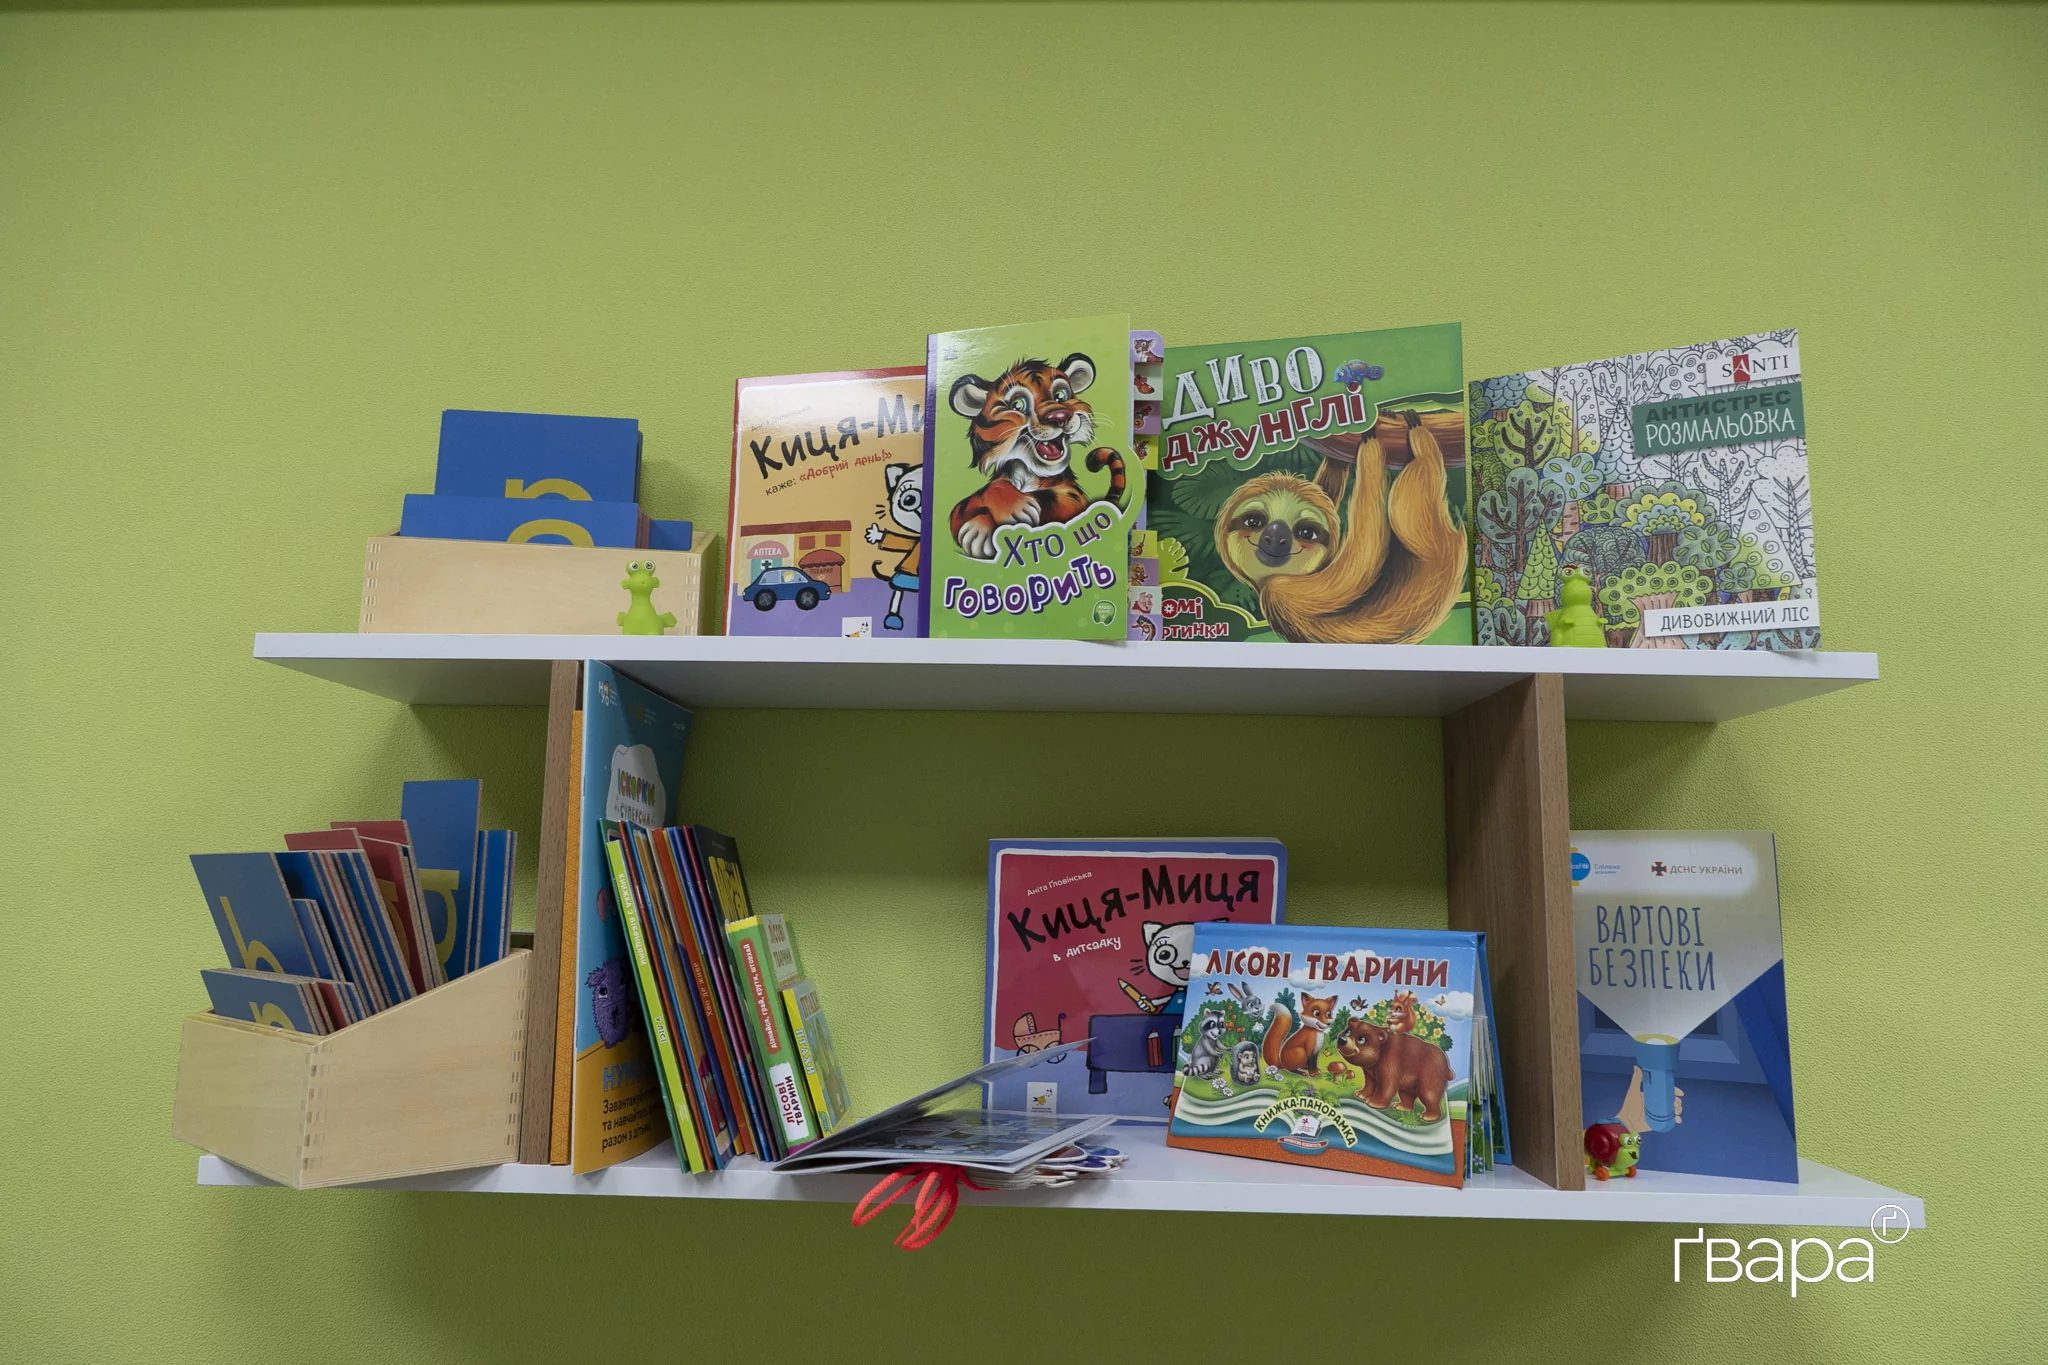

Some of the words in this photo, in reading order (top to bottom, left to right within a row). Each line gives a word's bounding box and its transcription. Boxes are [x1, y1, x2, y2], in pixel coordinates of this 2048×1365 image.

[1722, 354, 1789, 377] SANTI
[1163, 346, 1324, 430] ДИВО
[1646, 390, 1791, 422] АНТИСТРЕС
[1645, 408, 1796, 448] РОЗМАЛЬОВКА
[765, 477, 797, 496] каже:
[799, 459, 849, 482] «Добрий
[754, 547, 782, 556] АПТЕКА
[1003, 533, 1065, 568] Хто
[943, 554, 1116, 618] Говорить
[1661, 607, 1776, 632] ДИВОВИЖНИЙ
[1781, 606, 1810, 623] ЛІС
[1027, 884, 1048, 897] Аніта
[1048, 871, 1093, 889] Ґловінська
[1670, 865, 1697, 875] ДСНС
[1699, 865, 1743, 875] УКРАЇНИ
[1007, 865, 1260, 952] Киця-Миця
[1596, 905, 1705, 947] ВАРТОВІ
[1053, 952, 1061, 962] в
[1066, 936, 1121, 959] дитсадку
[1205, 949, 1292, 979] ЛІСОВІ
[1306, 953, 1449, 988] ТВАРИНИ
[1588, 947, 1716, 991] БЕЗПЕКИ
[784, 1075, 804, 1126] ТВАРИНИ
[1255, 1097, 1356, 1146] КНИЖКА-ПАНОРАМКА
[601, 1132, 628, 1153] разом
